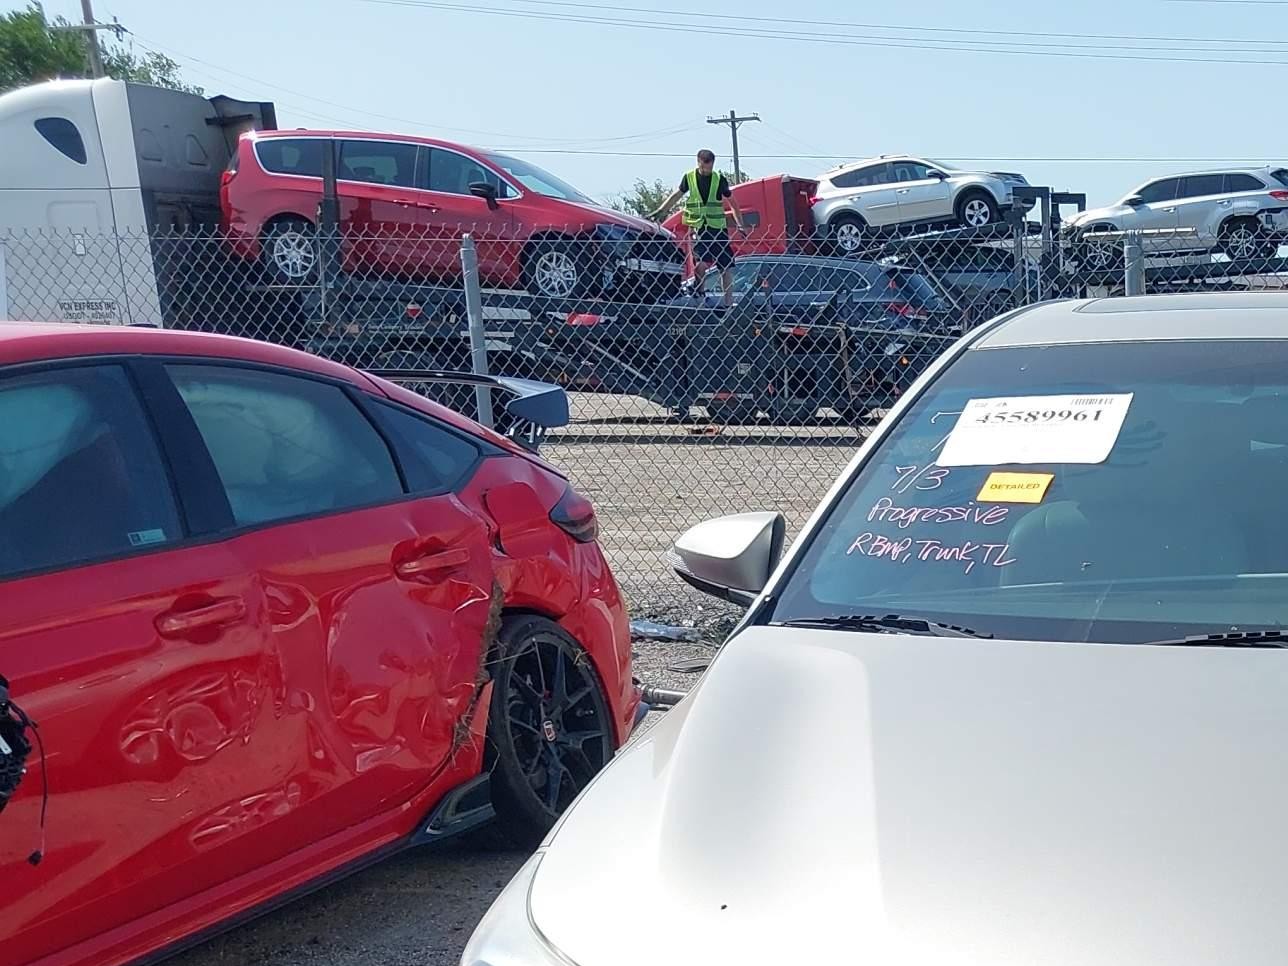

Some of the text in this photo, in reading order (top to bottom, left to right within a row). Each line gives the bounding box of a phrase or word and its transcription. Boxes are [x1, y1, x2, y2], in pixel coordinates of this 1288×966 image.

[75, 302, 103, 311] EXPRESS
[975, 409, 1104, 424] 45589961
[891, 462, 950, 494] 7/3
[990, 482, 1040, 490] DETAILED
[867, 497, 1009, 528] Progressive
